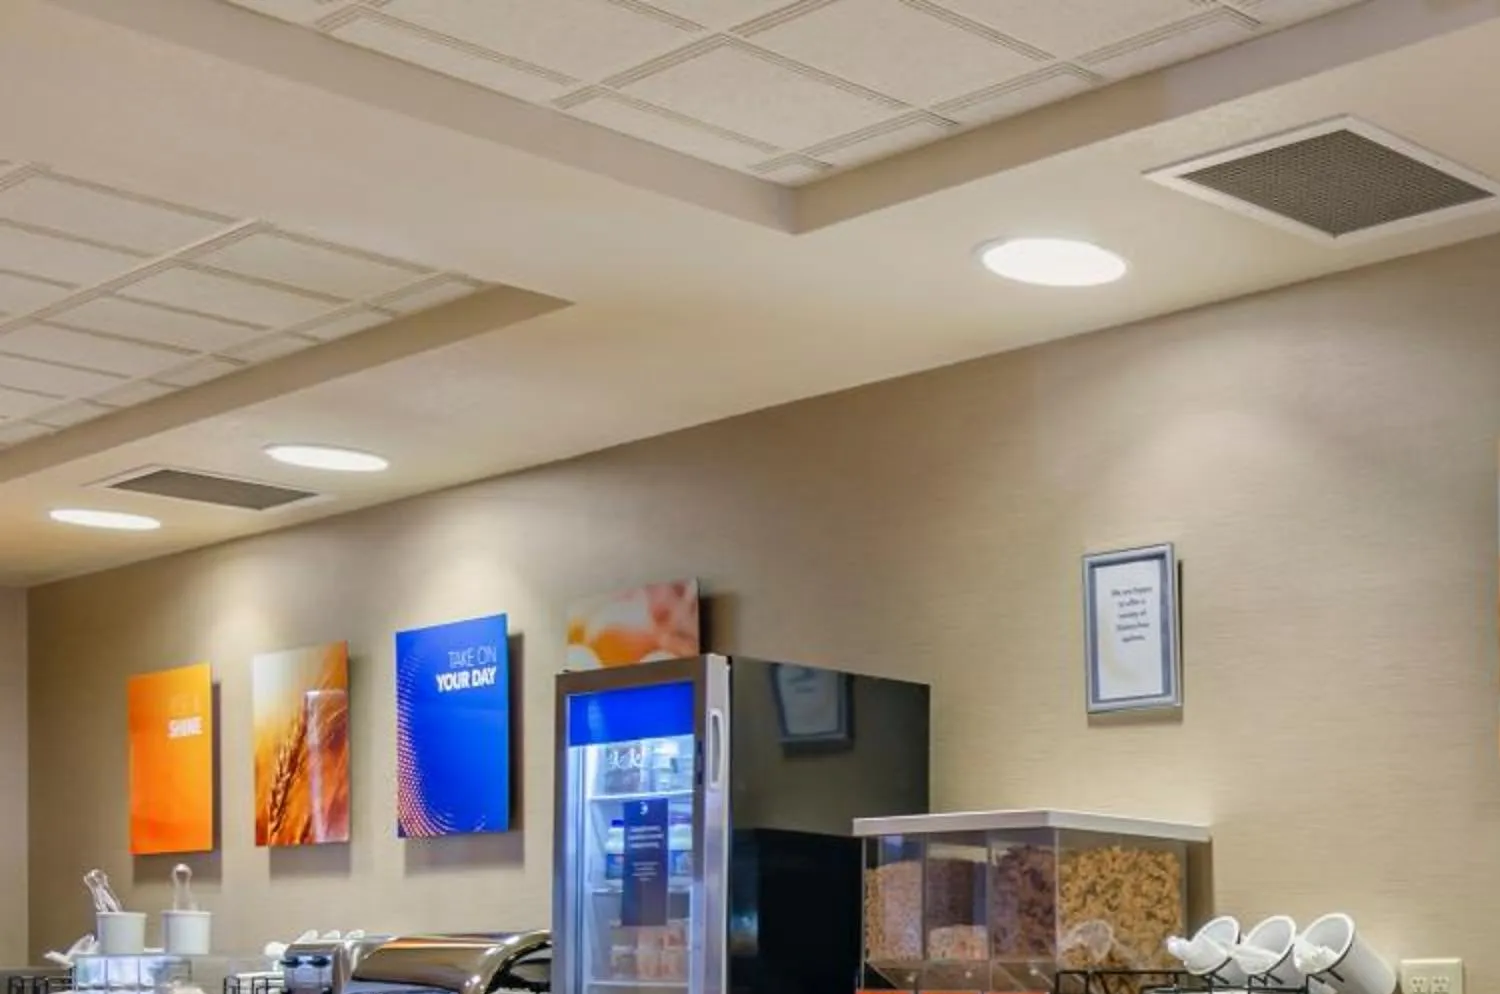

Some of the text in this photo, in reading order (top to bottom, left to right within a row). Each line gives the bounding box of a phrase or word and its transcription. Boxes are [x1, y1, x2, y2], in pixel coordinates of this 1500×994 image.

[447, 645, 497, 670] TAKE ON
[435, 666, 497, 693] YOUR DAY
